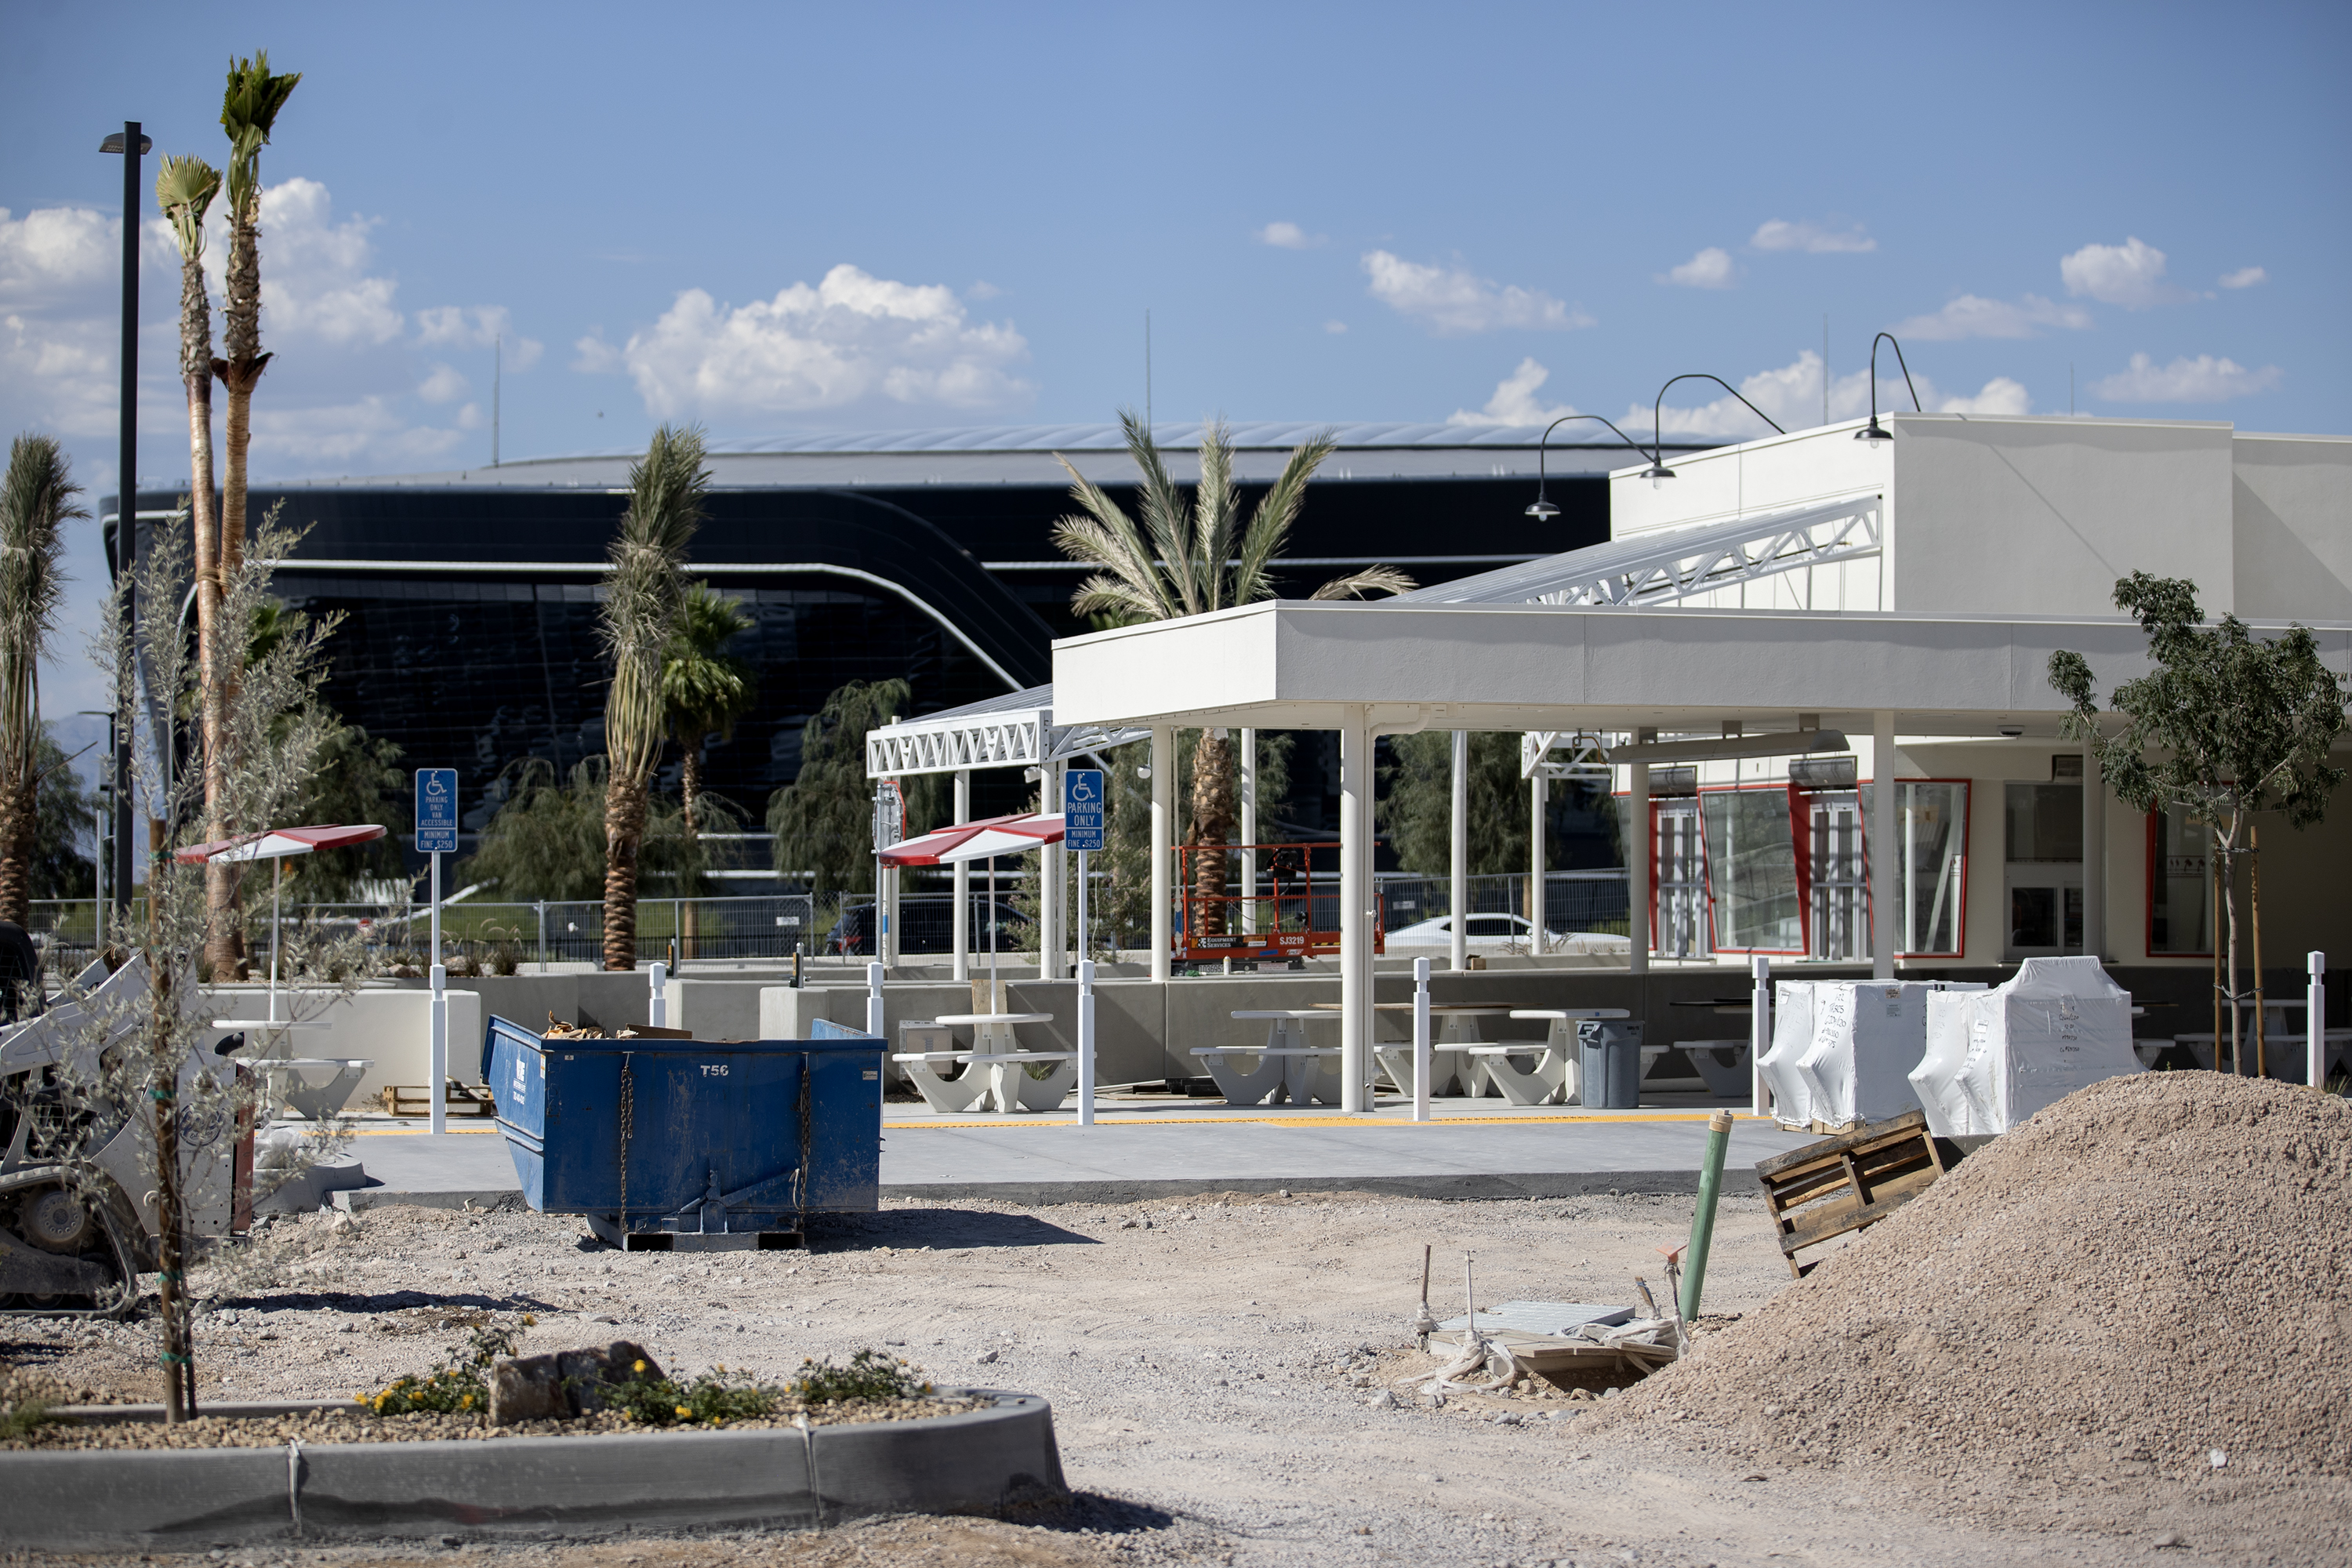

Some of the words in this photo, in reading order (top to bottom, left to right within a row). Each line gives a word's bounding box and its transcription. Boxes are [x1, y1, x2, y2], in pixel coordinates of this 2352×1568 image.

[1067, 802, 1102, 814] PARKING
[1074, 815, 1095, 826] ONLY
[420, 840, 434, 848] FINE
[437, 840, 453, 849] $250
[1068, 839, 1080, 848] FINE
[1084, 839, 1101, 848] $250
[1279, 935, 1305, 946] SJ3219
[700, 1065, 729, 1077] T56
